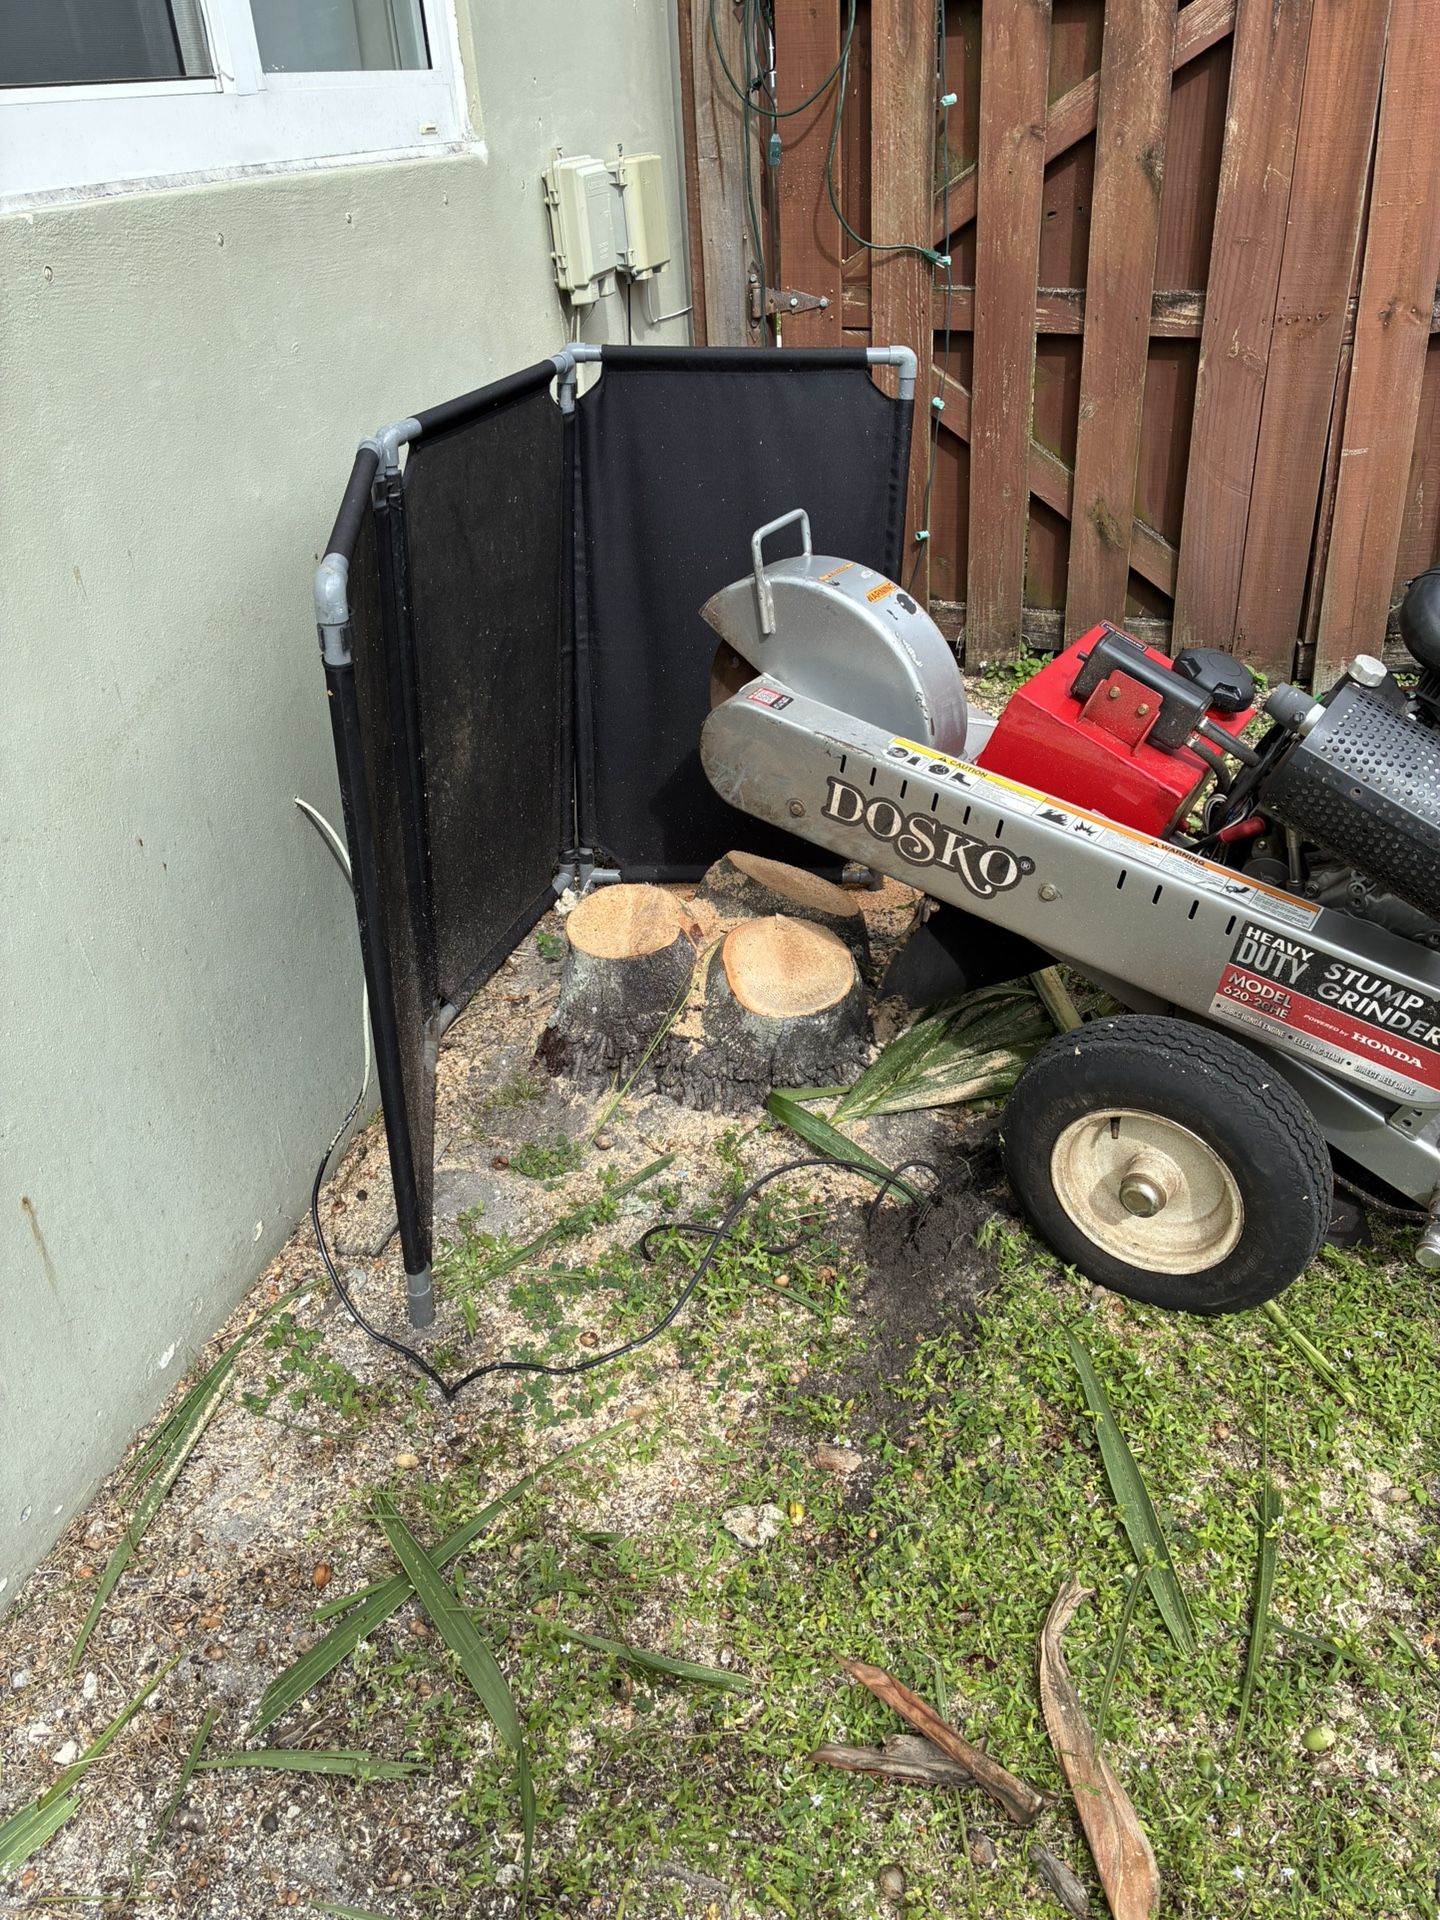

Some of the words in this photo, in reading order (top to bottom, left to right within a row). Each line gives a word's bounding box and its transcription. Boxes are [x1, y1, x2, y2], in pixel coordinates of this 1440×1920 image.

[950, 760, 988, 778] CAUTION
[826, 780, 1019, 896] DOSKO
[1161, 844, 1206, 866] WARNING
[1236, 939, 1310, 985] DUTY
[1245, 926, 1315, 962] HEAVY
[1228, 972, 1293, 1009] MODEL
[1324, 963, 1425, 1010] STUMP
[1242, 1013, 1263, 1030] HONDA
[1261, 1021, 1287, 1039] ENGINE
[1303, 1014, 1340, 1032] POWERED
[1317, 983, 1440, 1046] GRINDER
[1322, 1047, 1346, 1065] START
[1351, 1031, 1423, 1069] HONDA
[1353, 1064, 1379, 1081] DIRECT
[1393, 1081, 1417, 1097] DRIVE
